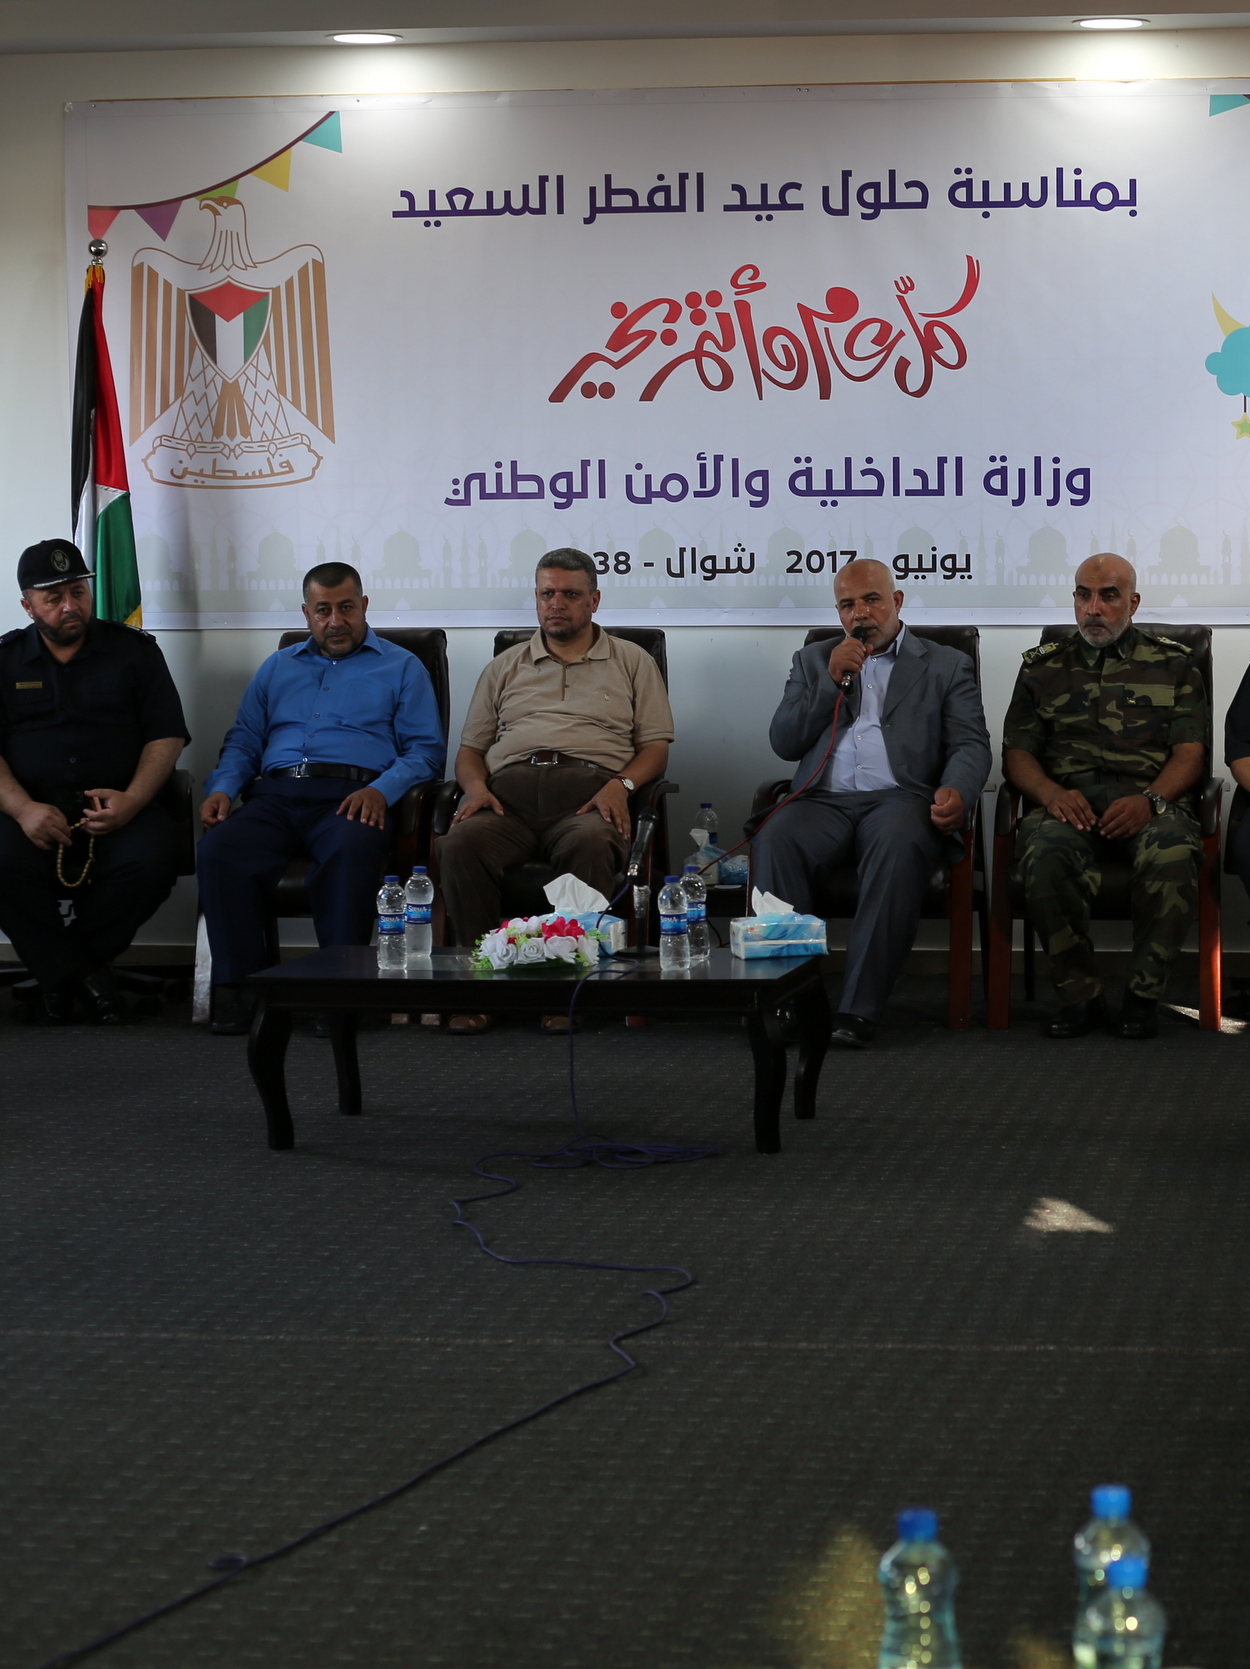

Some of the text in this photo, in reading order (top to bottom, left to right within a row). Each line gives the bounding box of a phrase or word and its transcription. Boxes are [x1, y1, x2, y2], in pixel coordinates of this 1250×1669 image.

[392, 167, 1137, 228] بمناسبة حلول عيد الفطر السعيد
[548, 297, 683, 404] بخير
[170, 453, 295, 484] فلسطين
[444, 453, 1091, 510] وزارة الداخلية والأمن الوطني
[593, 550, 632, 576] 38
[666, 543, 756, 582] شوال
[786, 549, 858, 575] 2017
[892, 545, 973, 581] يونيو
